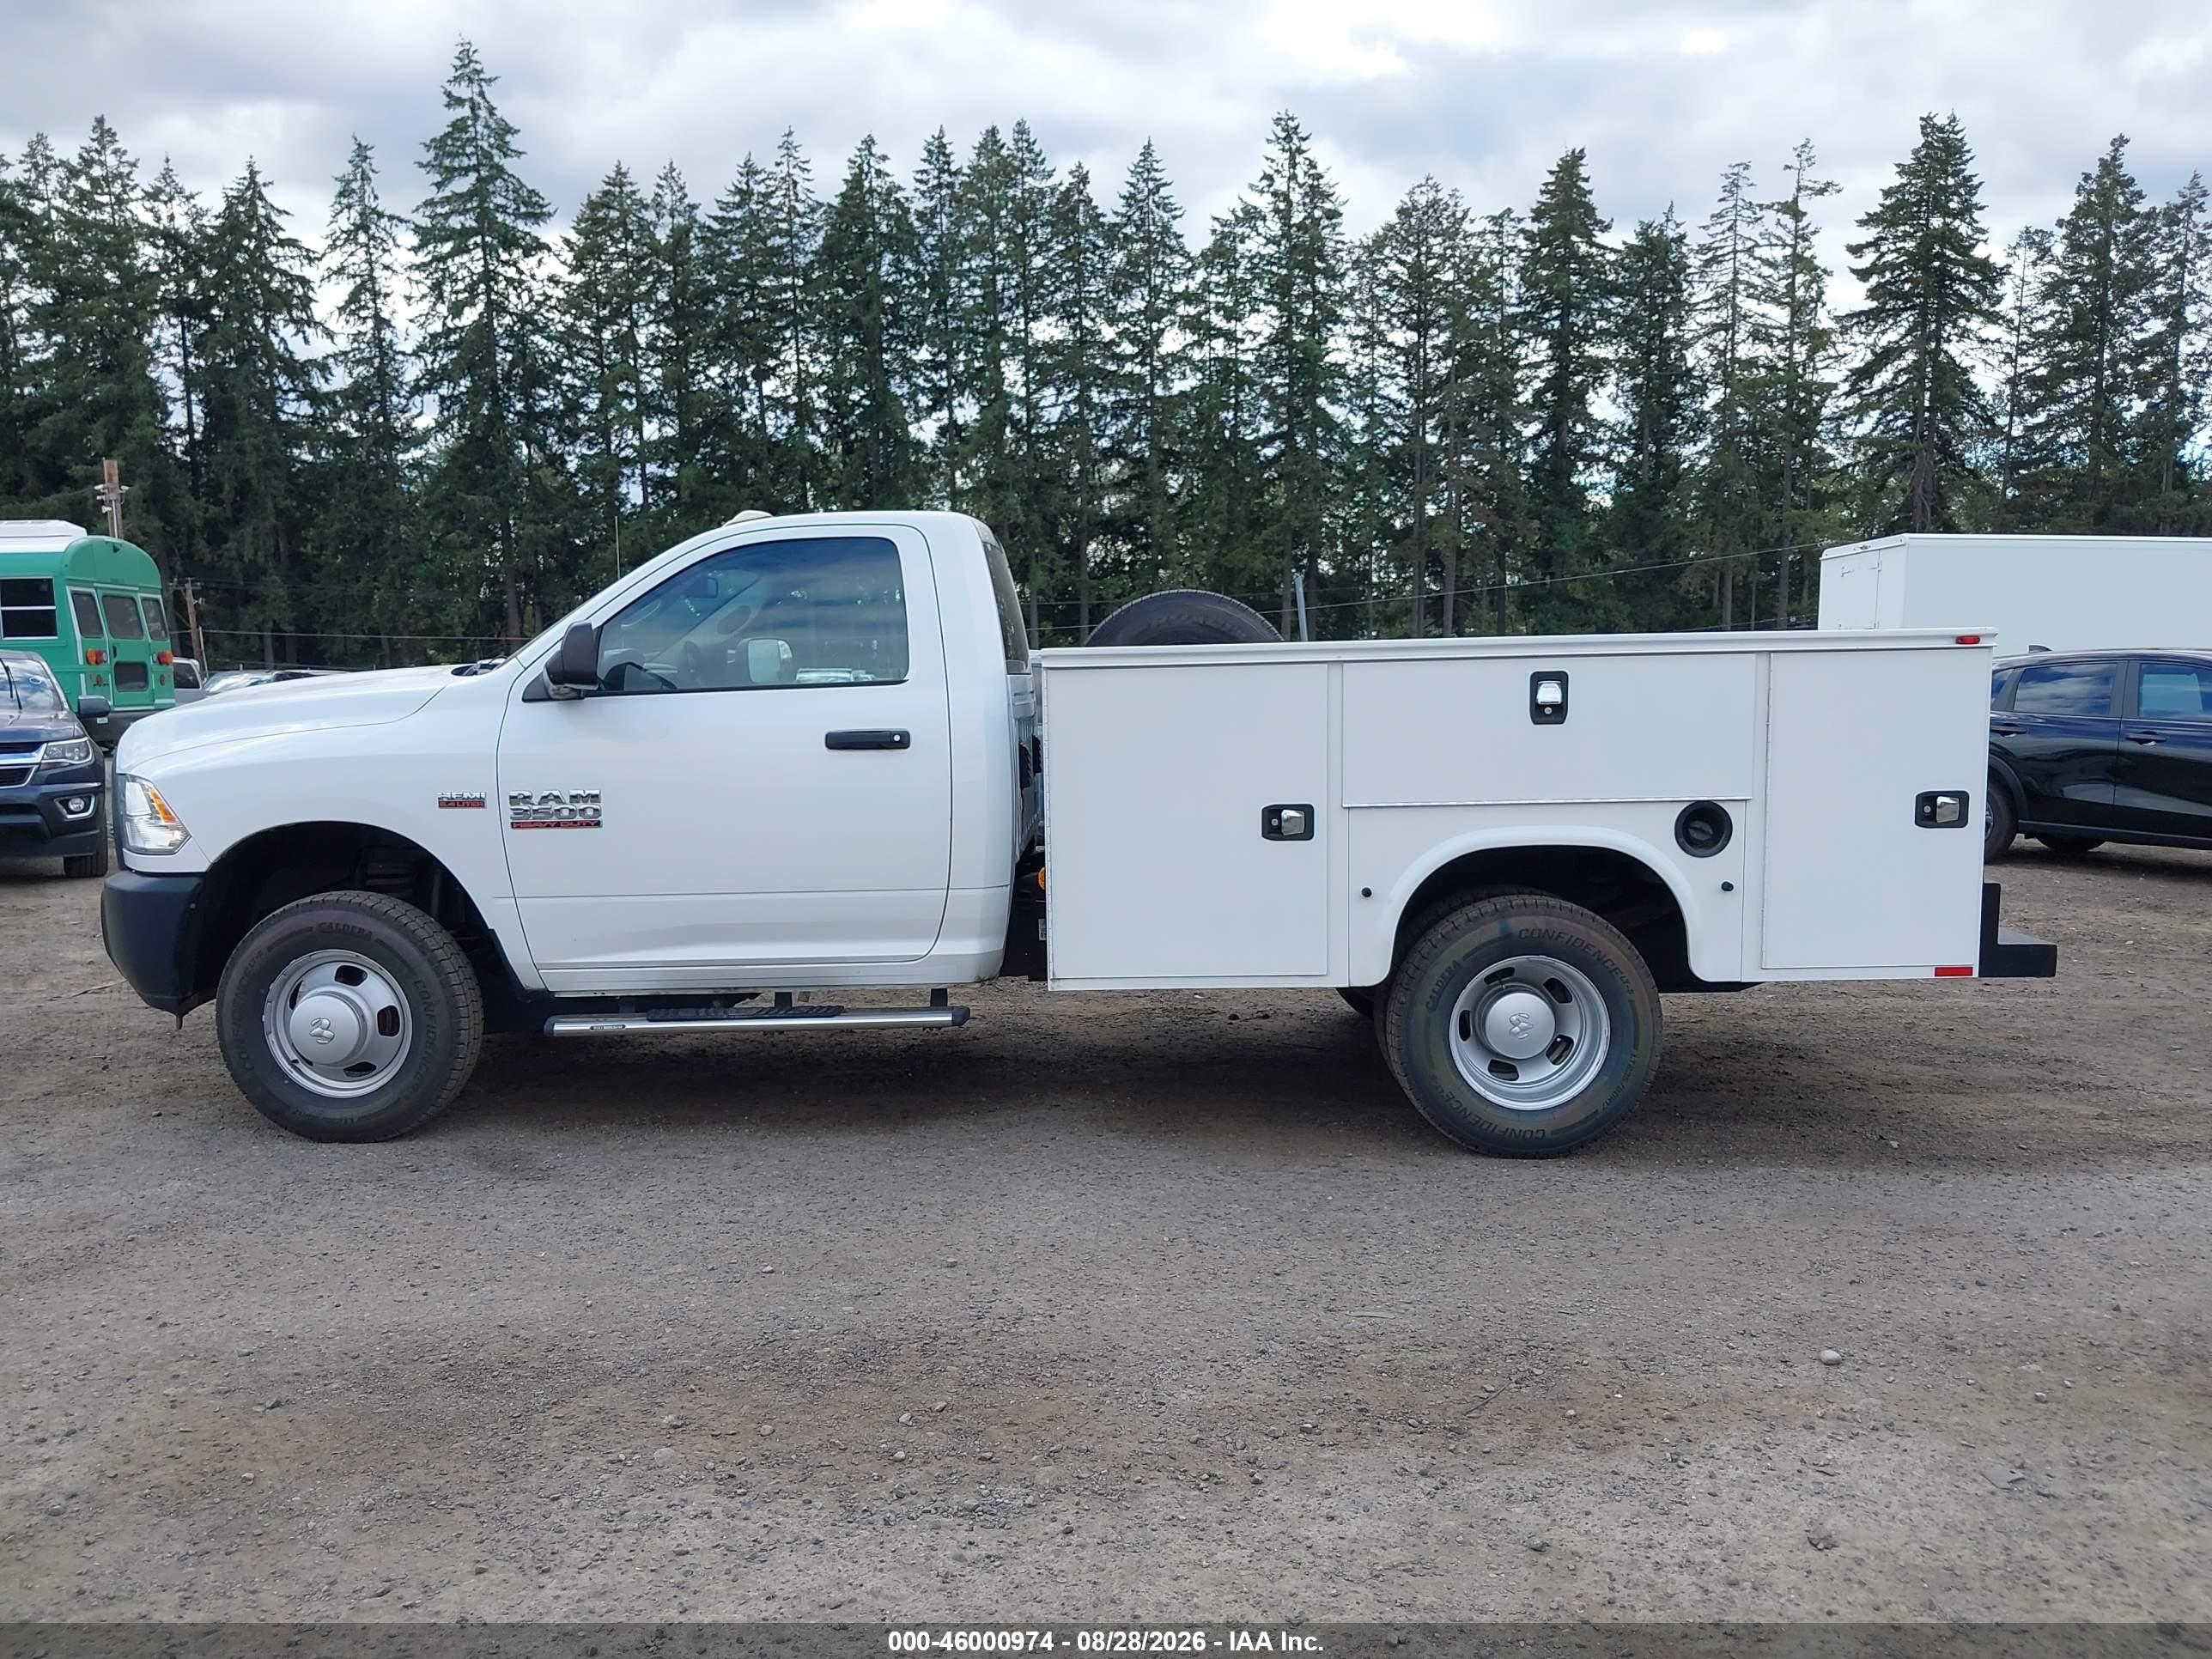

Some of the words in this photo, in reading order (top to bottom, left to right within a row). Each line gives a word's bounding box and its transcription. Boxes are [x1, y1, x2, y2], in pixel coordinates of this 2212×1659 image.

[436, 792, 486, 800] HEMI
[509, 789, 601, 805] RAM
[509, 804, 602, 820] 3500
[560, 820, 598, 829] DUTY
[319, 921, 373, 940] CALDERA
[1517, 927, 1624, 979] CONFIDENCE
[1425, 960, 1462, 1012] CALDERA
[1441, 1090, 1547, 1140] CONFIDENCE
